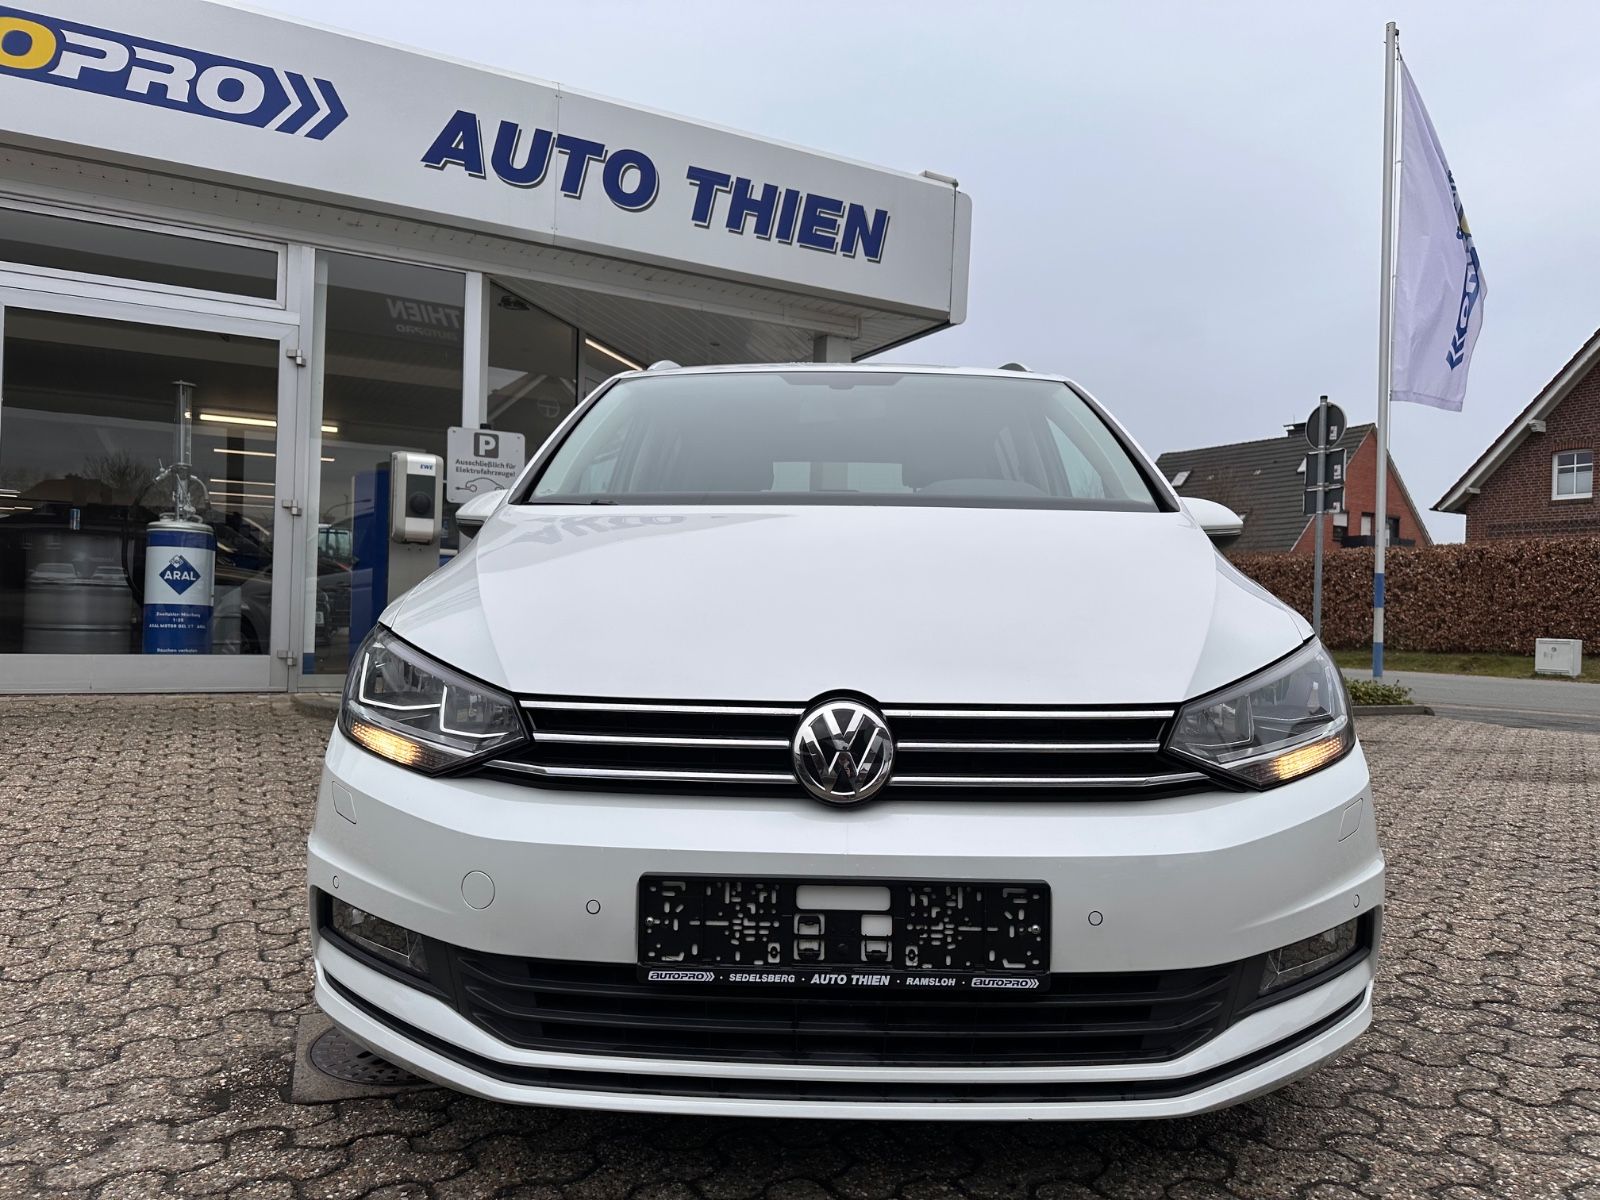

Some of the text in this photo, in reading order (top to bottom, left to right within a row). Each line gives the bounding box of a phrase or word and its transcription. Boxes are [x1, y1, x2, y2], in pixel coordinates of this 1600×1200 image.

[421, 109, 890, 263] AUTO THIEN
[479, 434, 496, 456] P
[455, 459, 516, 470] Ausschließlich für
[163, 570, 197, 581] ARAL
[728, 973, 796, 983] SEDELSBERG
[811, 973, 847, 985] AUTO
[851, 974, 891, 986] THIEN
[905, 977, 957, 987] RAMSLOH
